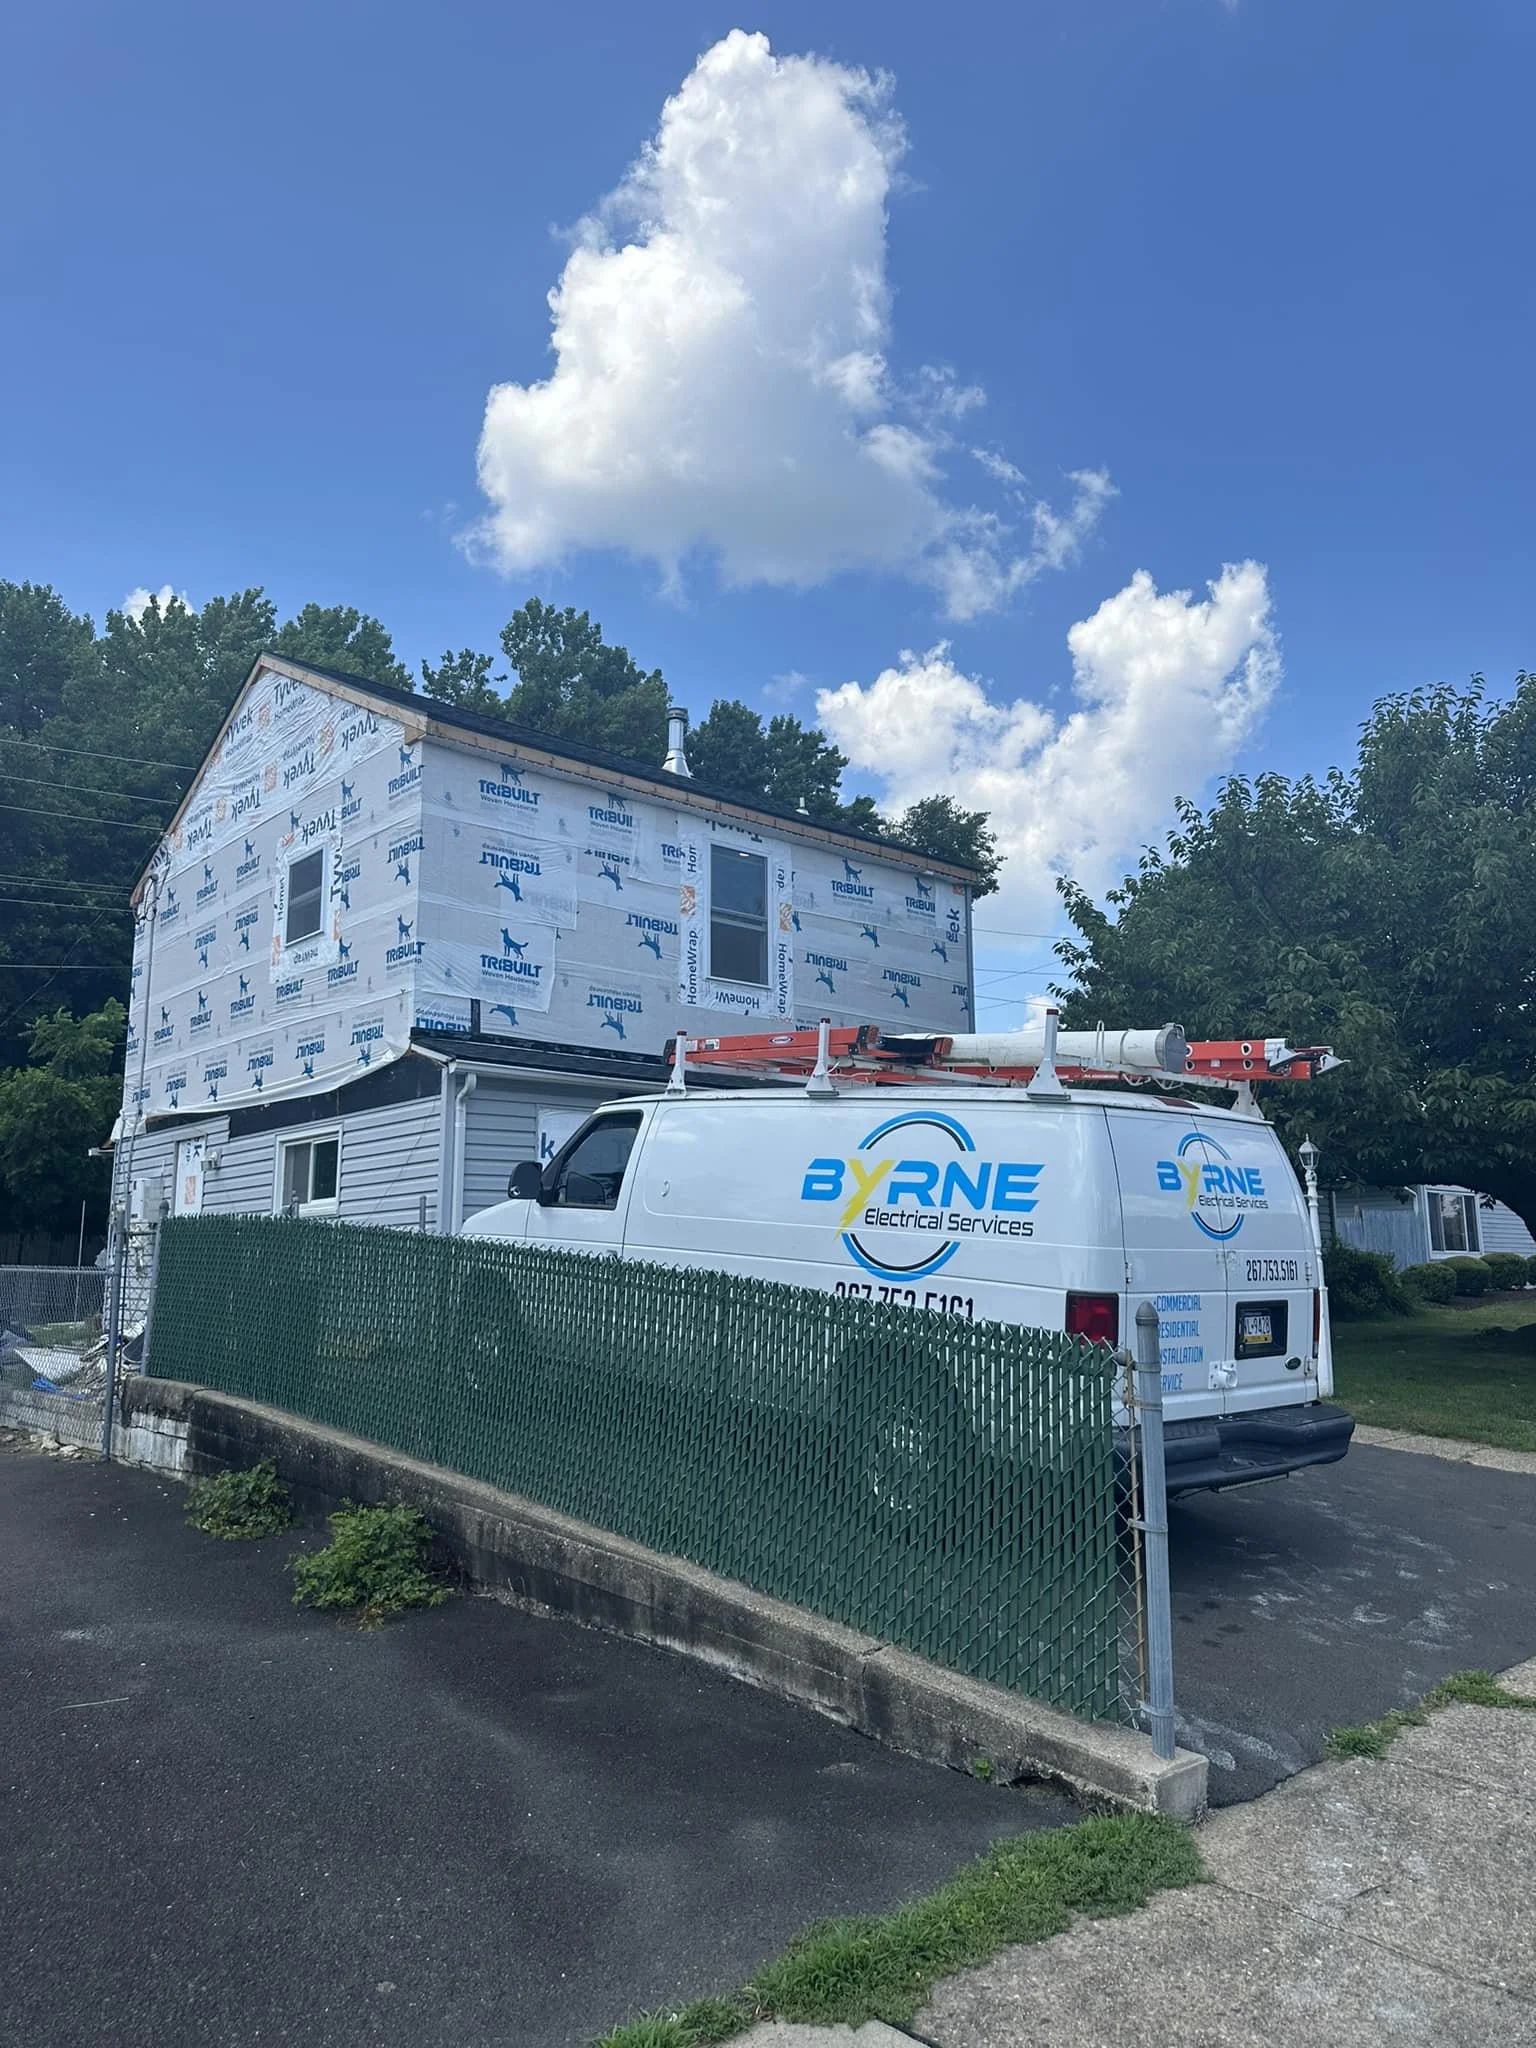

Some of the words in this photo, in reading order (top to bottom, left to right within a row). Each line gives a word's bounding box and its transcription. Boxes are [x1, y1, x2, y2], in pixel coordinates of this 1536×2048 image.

[342, 711, 379, 751] Tyvek
[284, 751, 316, 789] Tyvek
[388, 764, 425, 794] TRIBUILT
[231, 786, 262, 822] Tyvek
[479, 780, 541, 805] TRIBUILT
[302, 809, 337, 845] Tyvek
[387, 837, 425, 864] TRIBUILT
[479, 851, 541, 876] TRIBUILT
[831, 880, 874, 898] TRIBUILT
[626, 913, 679, 935] TRIBUILT
[386, 941, 426, 964] TRIBUILT
[805, 952, 848, 971] TRIBUILT
[328, 959, 360, 983] TRIBUILT
[480, 954, 543, 978] TRIBUILT
[687, 930, 698, 1004] HomeWrap
[882, 969, 921, 987] TRIBUILT
[276, 978, 304, 999] TRIBUILT
[777, 943, 787, 1014] HomeWrap
[586, 994, 643, 1013] TRIBUILT
[350, 1025, 384, 1046] TRIBUILT
[1157, 1161, 1265, 1211] BYRNE
[801, 1158, 1045, 1241] BYRNE
[1198, 1195, 1234, 1208] Electrical
[1236, 1197, 1269, 1209] Services
[865, 1207, 944, 1230] Electrical
[948, 1213, 1034, 1237] Services
[1246, 1260, 1298, 1282] 267.753.5161
[1156, 1294, 1202, 1312] COMMERCIAL
